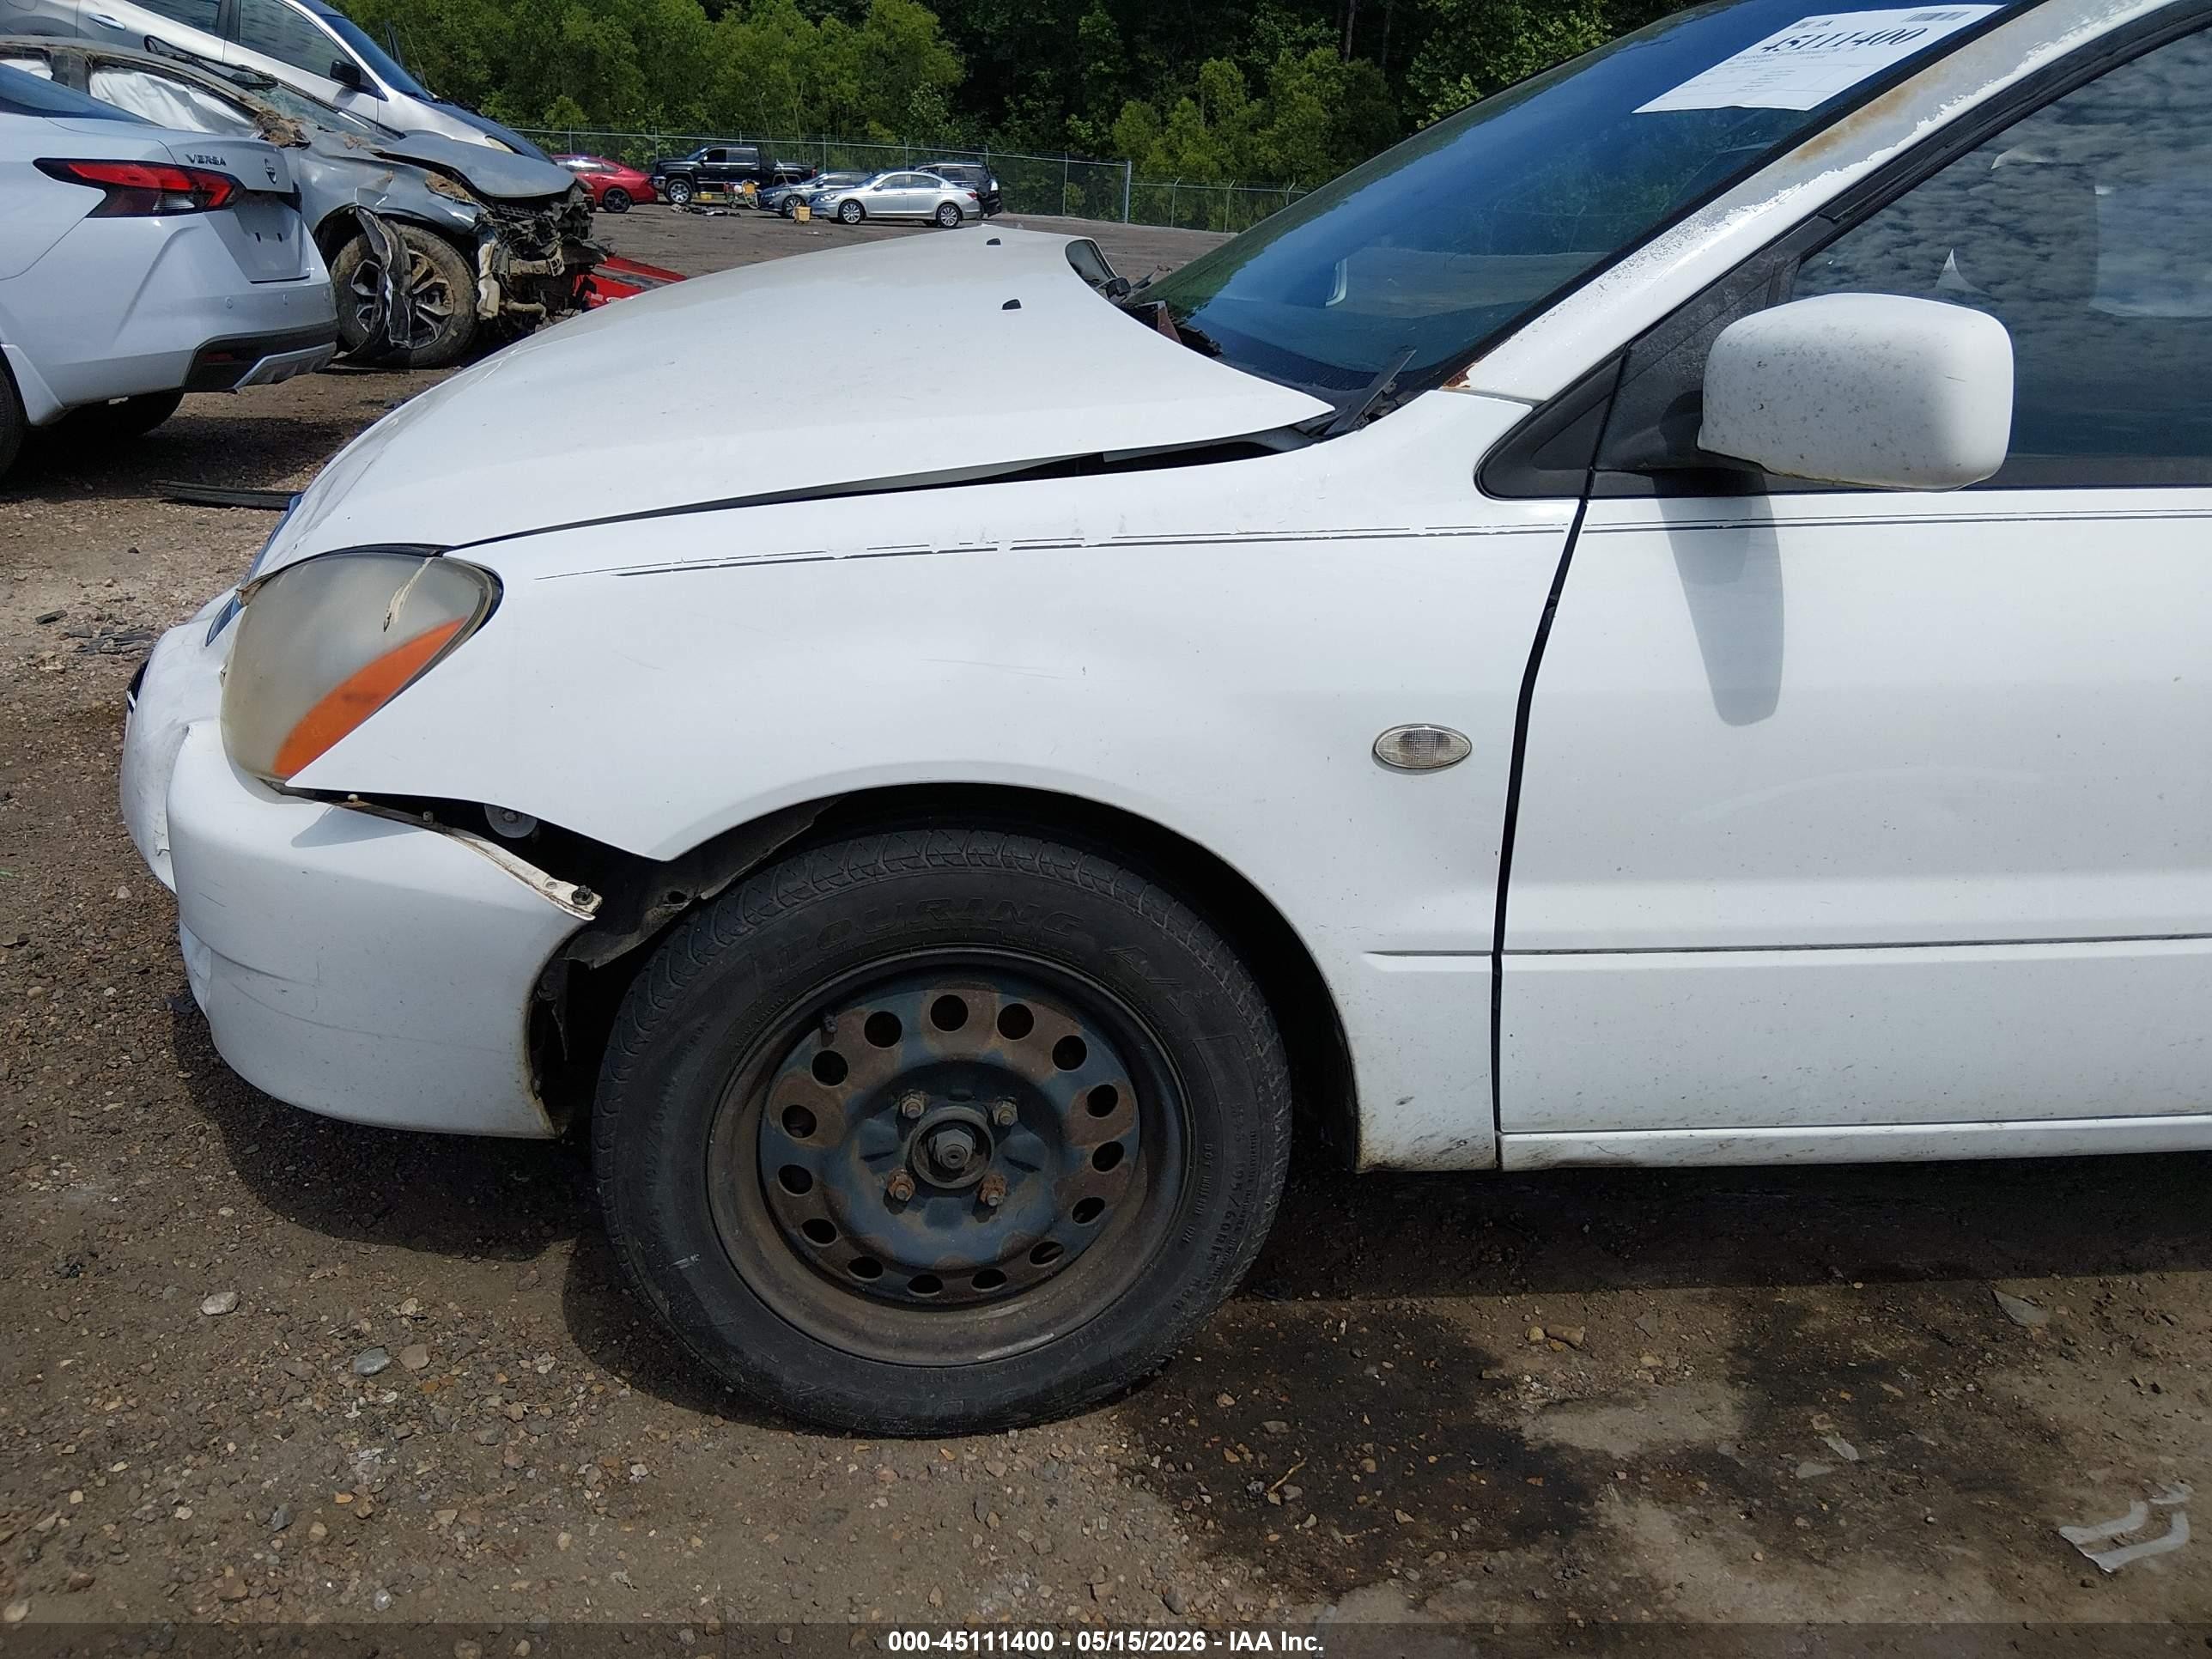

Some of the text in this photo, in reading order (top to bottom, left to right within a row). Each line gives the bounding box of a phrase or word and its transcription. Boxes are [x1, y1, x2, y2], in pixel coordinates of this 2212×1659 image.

[1760, 28, 1929, 52] 45111400
[185, 154, 227, 167] VERSA
[778, 897, 1085, 973] TOURING
